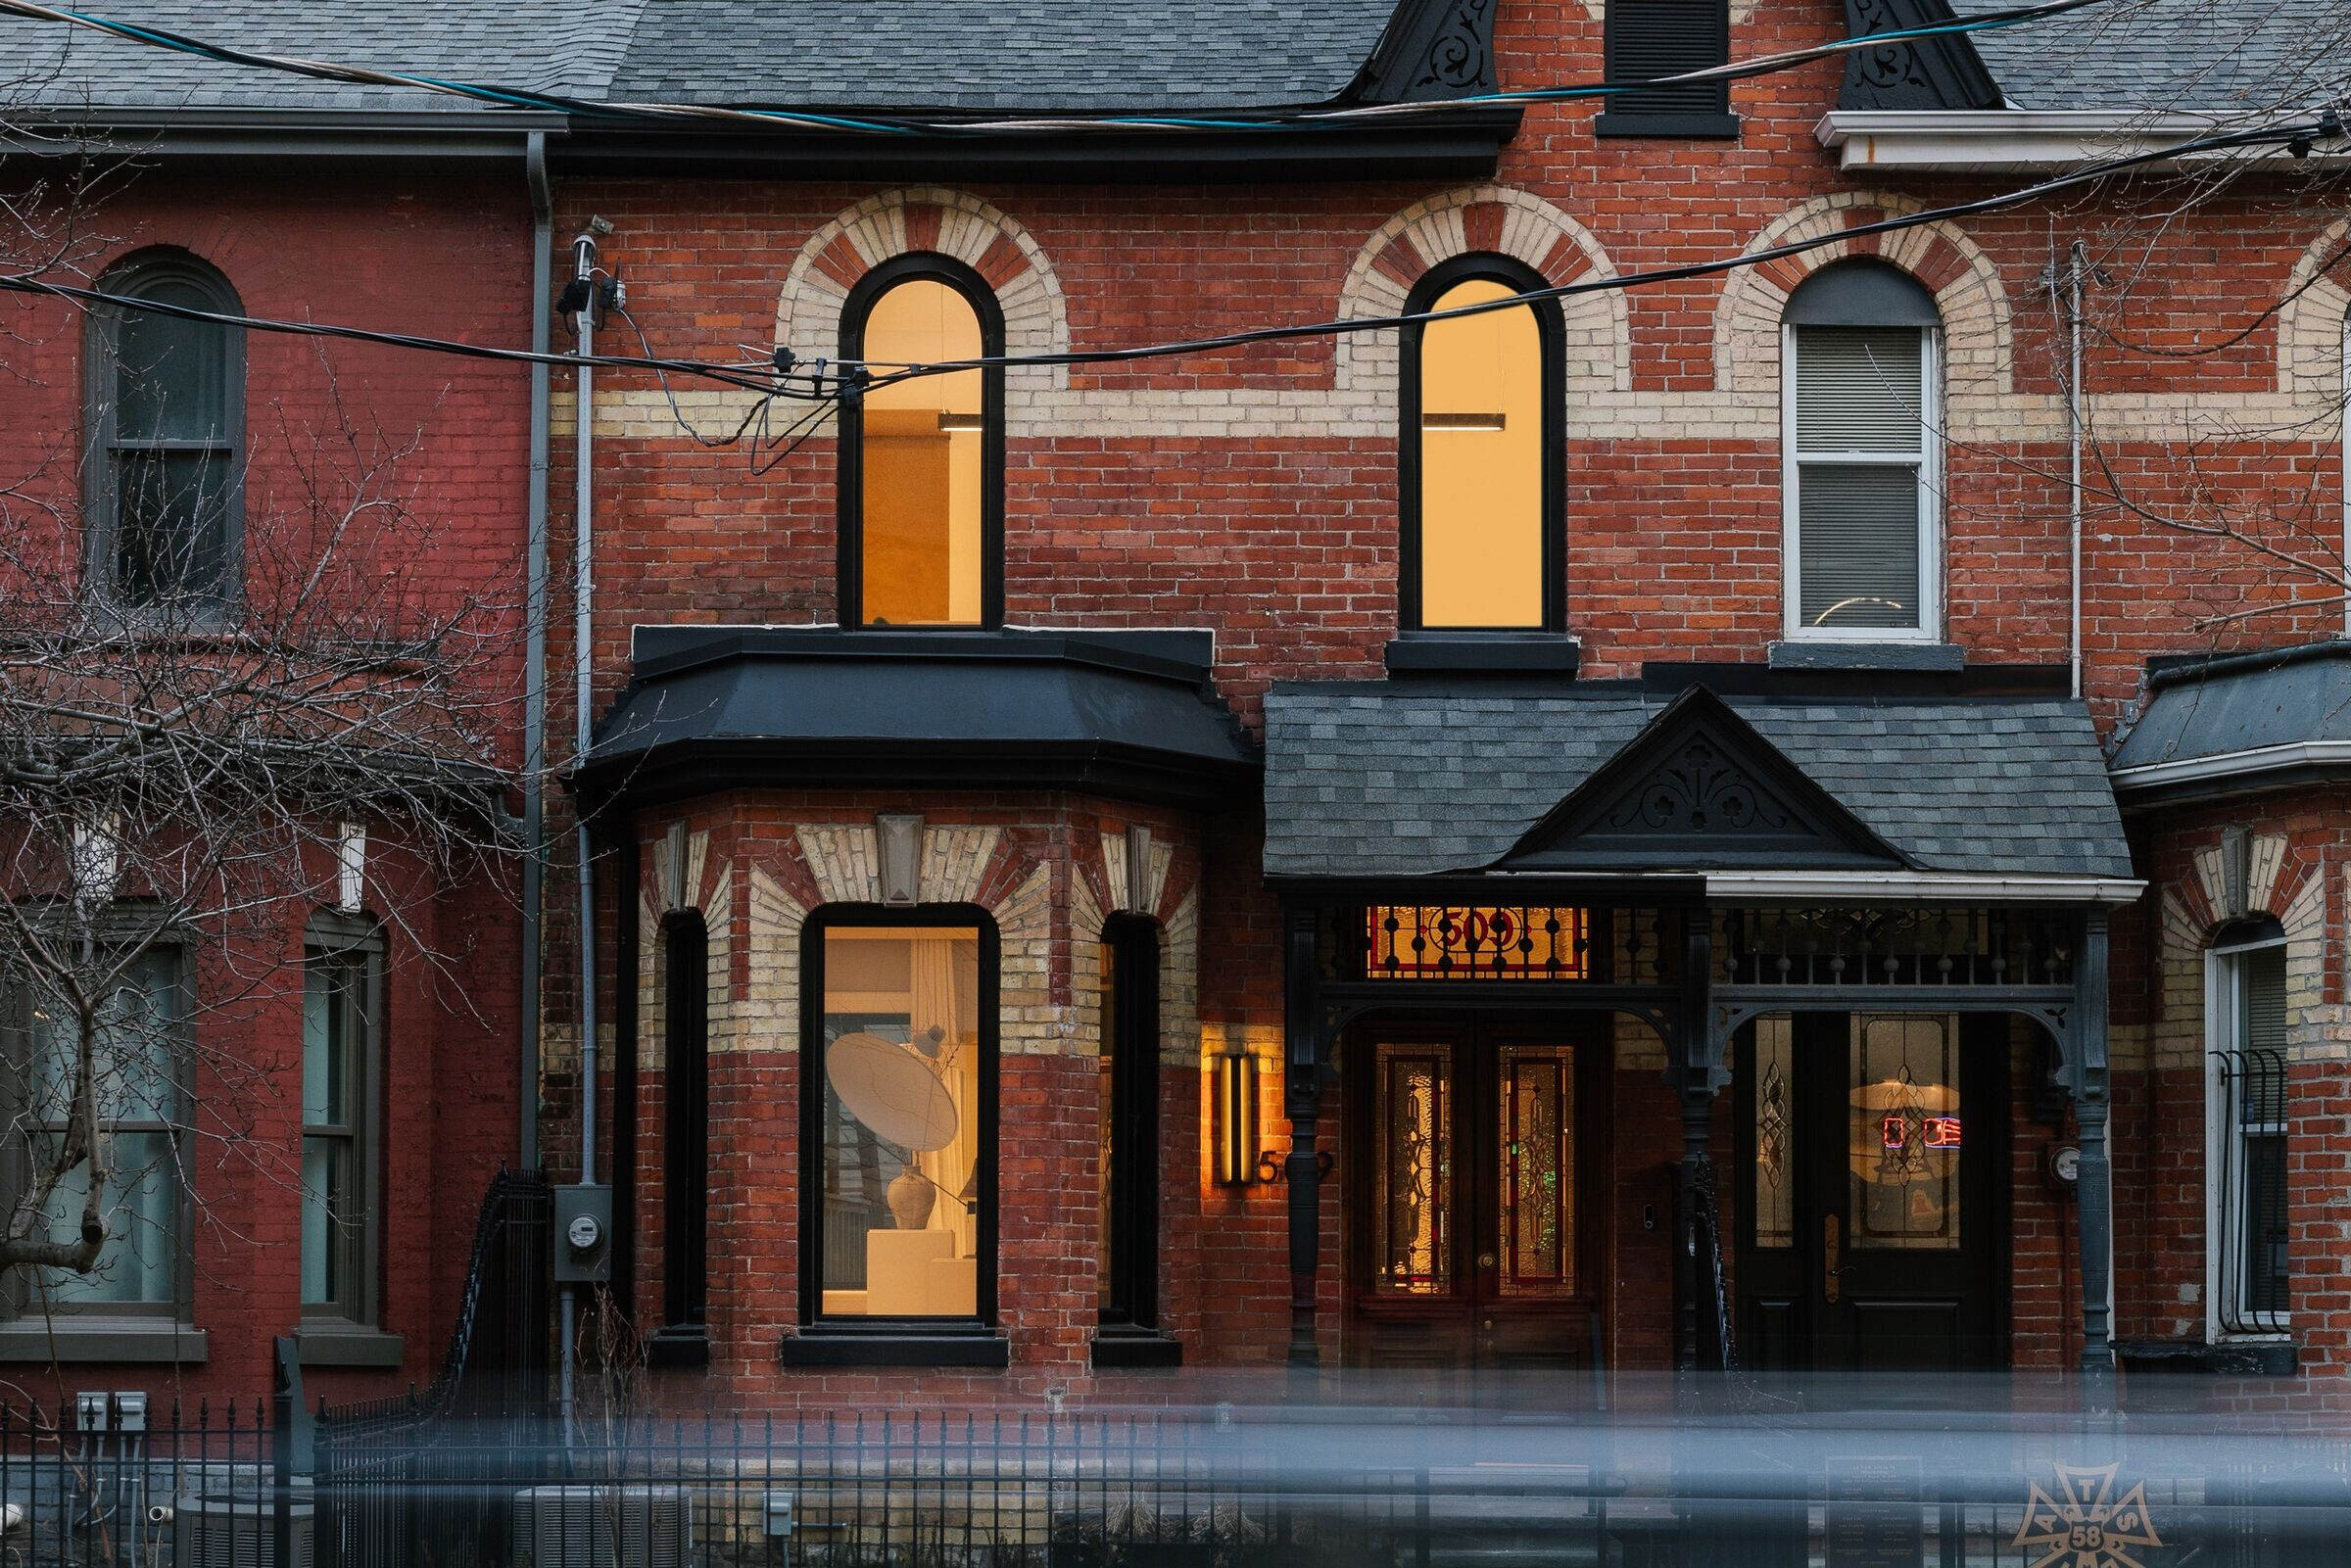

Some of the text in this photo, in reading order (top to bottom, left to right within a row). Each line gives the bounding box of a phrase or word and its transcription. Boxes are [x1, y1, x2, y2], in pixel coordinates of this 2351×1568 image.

[1441, 911, 1513, 947] 509
[1259, 1151, 1333, 1184] 59
[2072, 1525, 2102, 1547] 58
